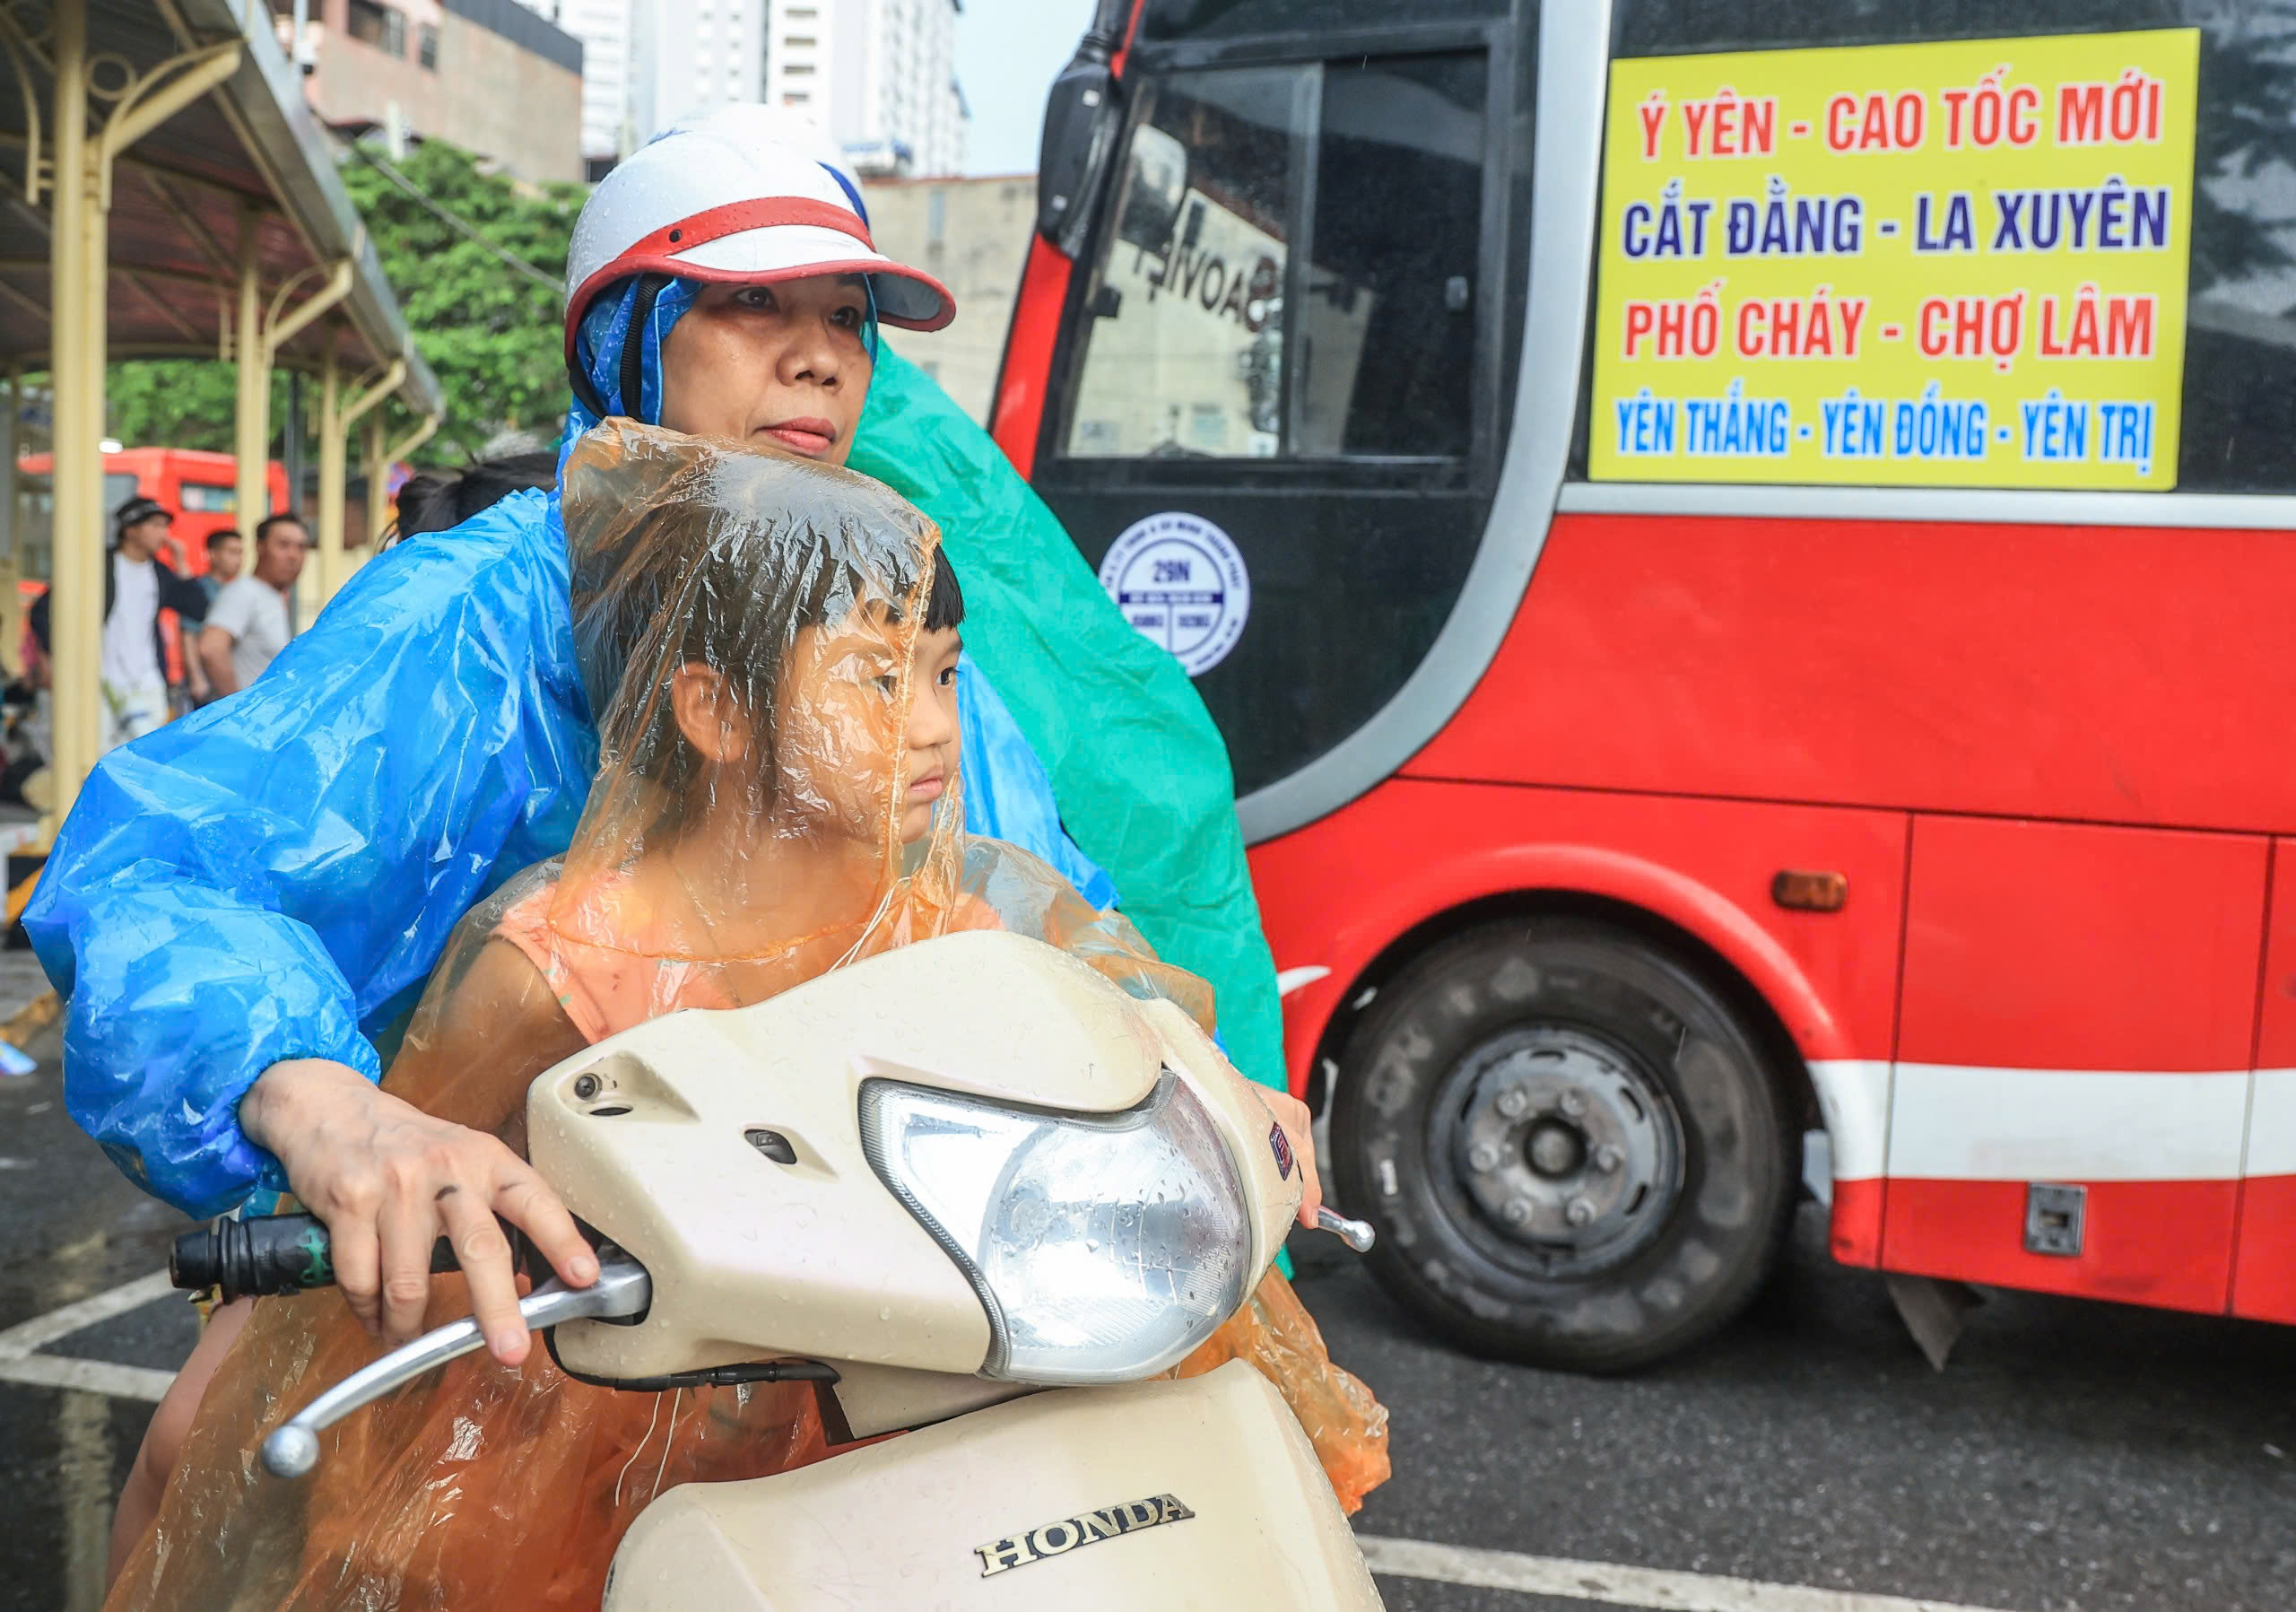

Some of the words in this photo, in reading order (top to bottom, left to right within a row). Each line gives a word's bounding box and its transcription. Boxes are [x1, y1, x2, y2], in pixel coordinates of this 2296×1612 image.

[1641, 92, 1665, 157] Ý
[1684, 90, 1773, 155] YÊN
[1828, 93, 1923, 151] CAO
[1944, 68, 2038, 146] TỐC
[2059, 71, 2159, 143] MỚI
[1727, 178, 1860, 254] ĐẰNG
[1918, 196, 1972, 250] LA
[1994, 178, 2166, 248] XUYÊN
[1625, 280, 1719, 356] PHỐ
[1737, 287, 1865, 356] CHÁY
[1920, 292, 2022, 370] CHỢ
[2041, 283, 2152, 356] LÂM
[1618, 389, 1675, 454] YÊN
[1823, 389, 1885, 455] YÊN
[2023, 391, 2088, 458] YÊN
[2100, 404, 2152, 474] TRỊ
[974, 1493, 1196, 1578] HONDA
